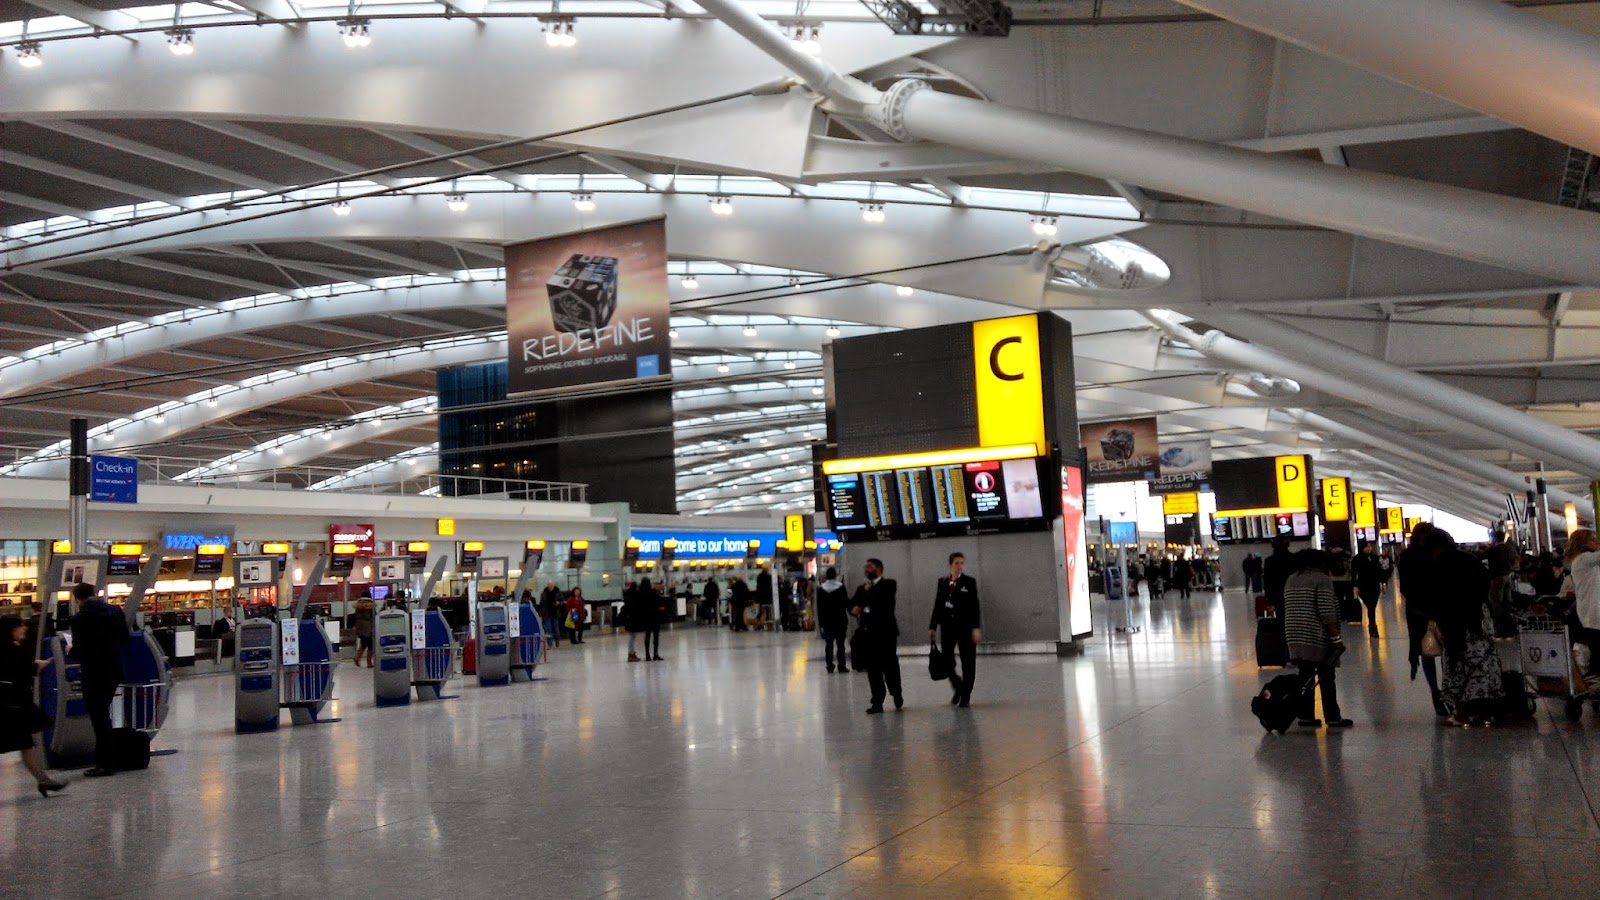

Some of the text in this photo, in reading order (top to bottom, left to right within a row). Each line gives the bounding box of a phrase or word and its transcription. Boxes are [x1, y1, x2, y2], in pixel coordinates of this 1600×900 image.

[523, 317, 655, 361] REDEFINE
[989, 336, 1025, 381] C
[96, 461, 134, 473] Check-in
[1089, 456, 1152, 472] REDEFINE
[1282, 464, 1299, 482] D
[1330, 484, 1339, 498] E
[1360, 496, 1367, 507] F
[1390, 509, 1398, 518] G
[792, 520, 799, 532] E
[698, 540, 708, 552] to
[708, 541, 723, 552] our
[724, 537, 748, 552] home
